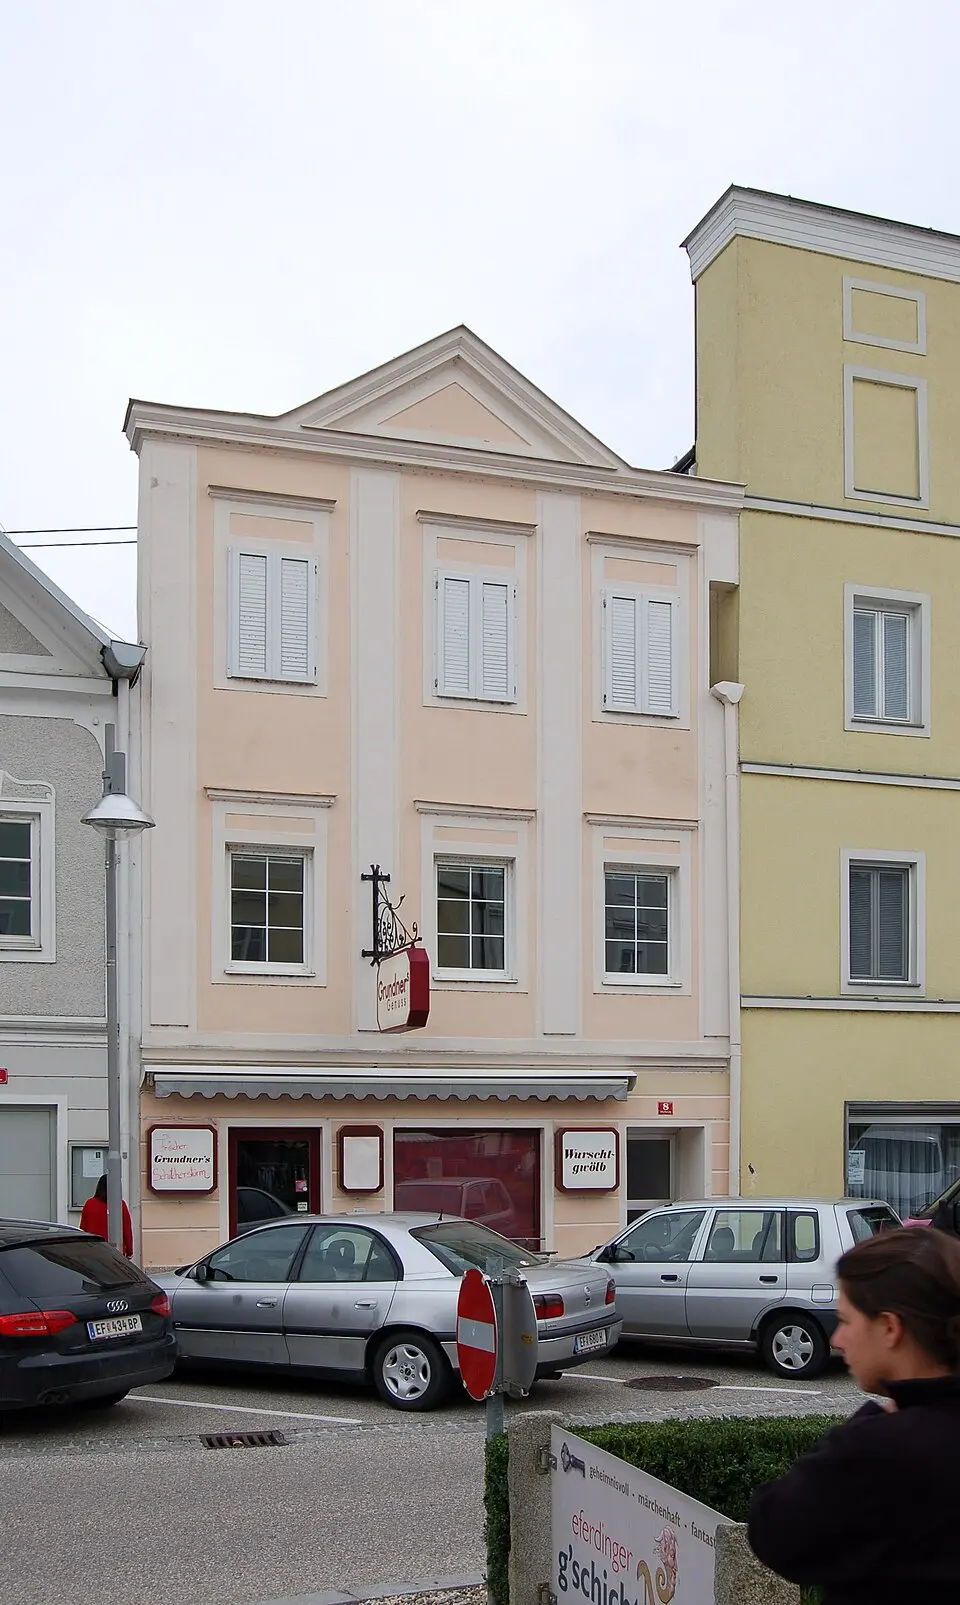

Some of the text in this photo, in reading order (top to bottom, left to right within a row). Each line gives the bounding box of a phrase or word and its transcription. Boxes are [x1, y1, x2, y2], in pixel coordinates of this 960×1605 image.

[387, 998, 407, 1012] Genuss
[662, 1102, 670, 1111] 8
[154, 1155, 211, 1164] Grundner's
[564, 1149, 615, 1160] Wurscht-
[572, 1162, 607, 1175] gwölb
[128, 1317, 138, 1330] BP
[589, 1465, 630, 1497] geheimnisvoll
[637, 1493, 681, 1528] märchenhaft
[571, 1509, 634, 1574] eferdinger
